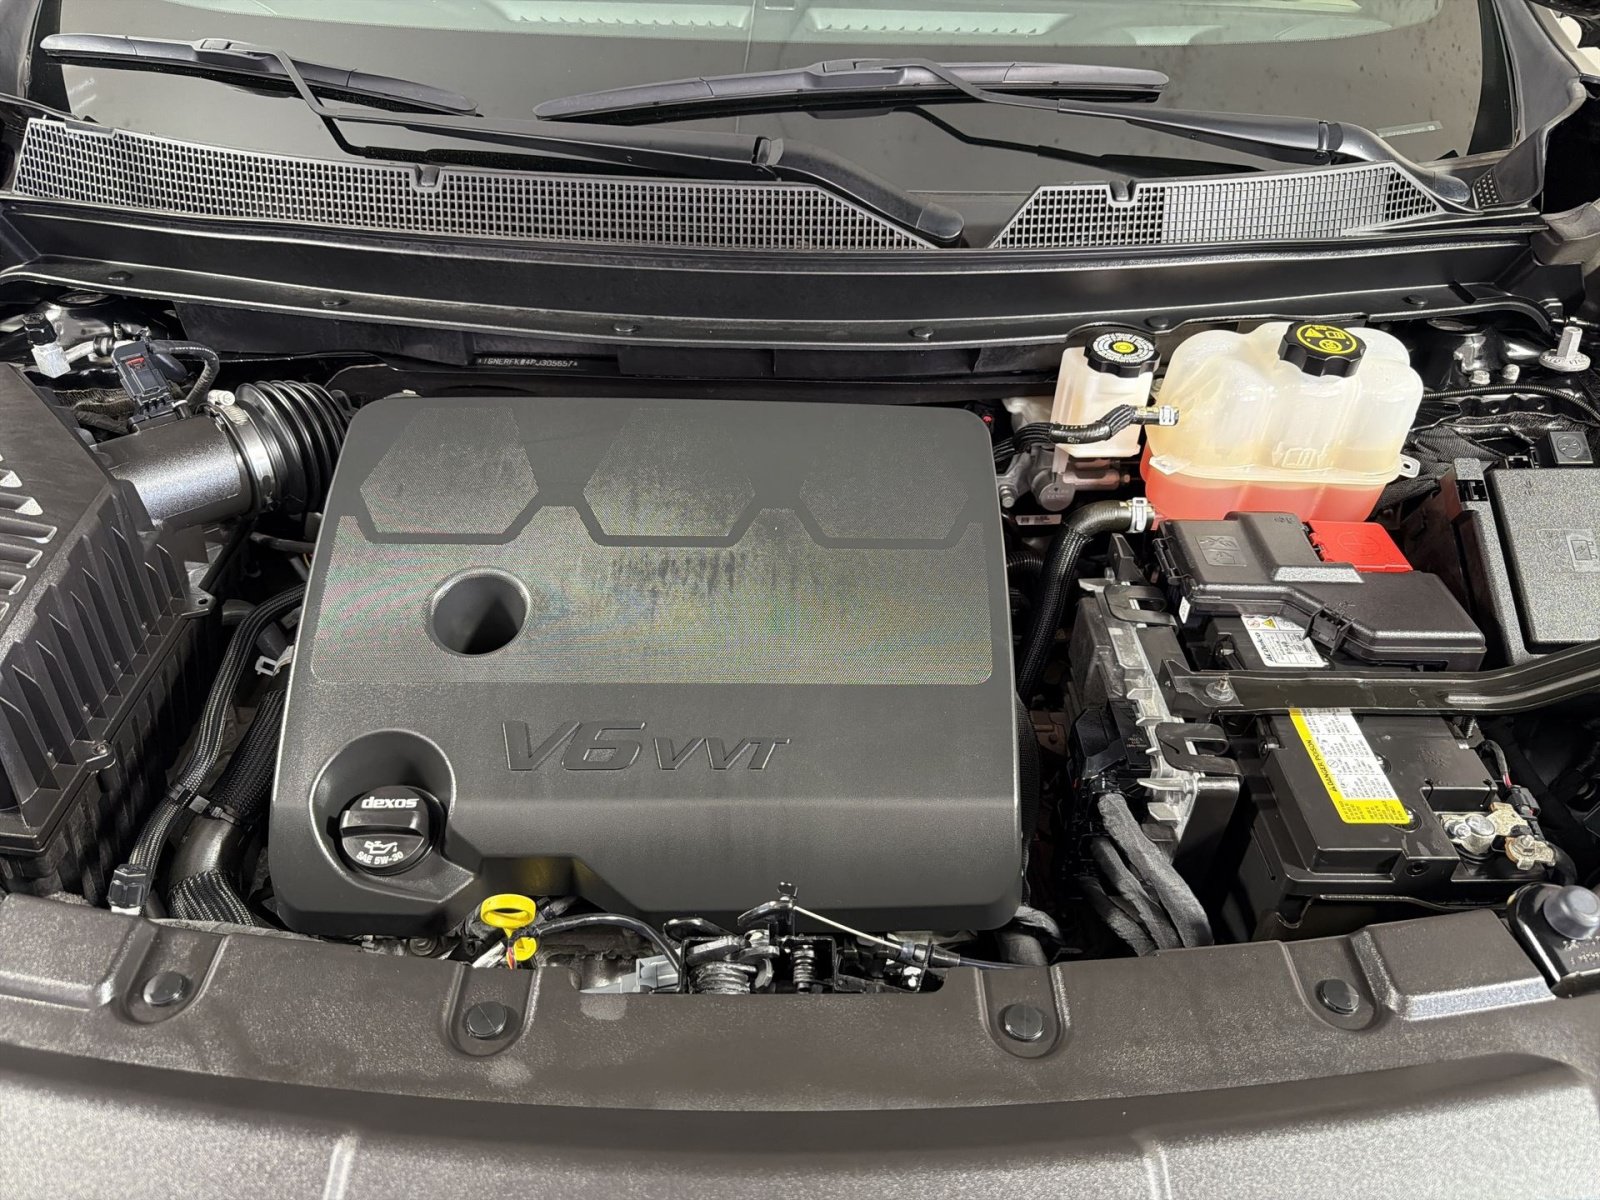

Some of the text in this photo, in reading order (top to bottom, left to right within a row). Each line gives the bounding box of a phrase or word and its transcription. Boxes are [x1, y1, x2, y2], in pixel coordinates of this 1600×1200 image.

[502, 720, 791, 771] V6 VVT
[1306, 740, 1334, 787] DANGER POISON
[361, 796, 420, 809] dexos
[356, 851, 404, 865] SAE 5W-30
